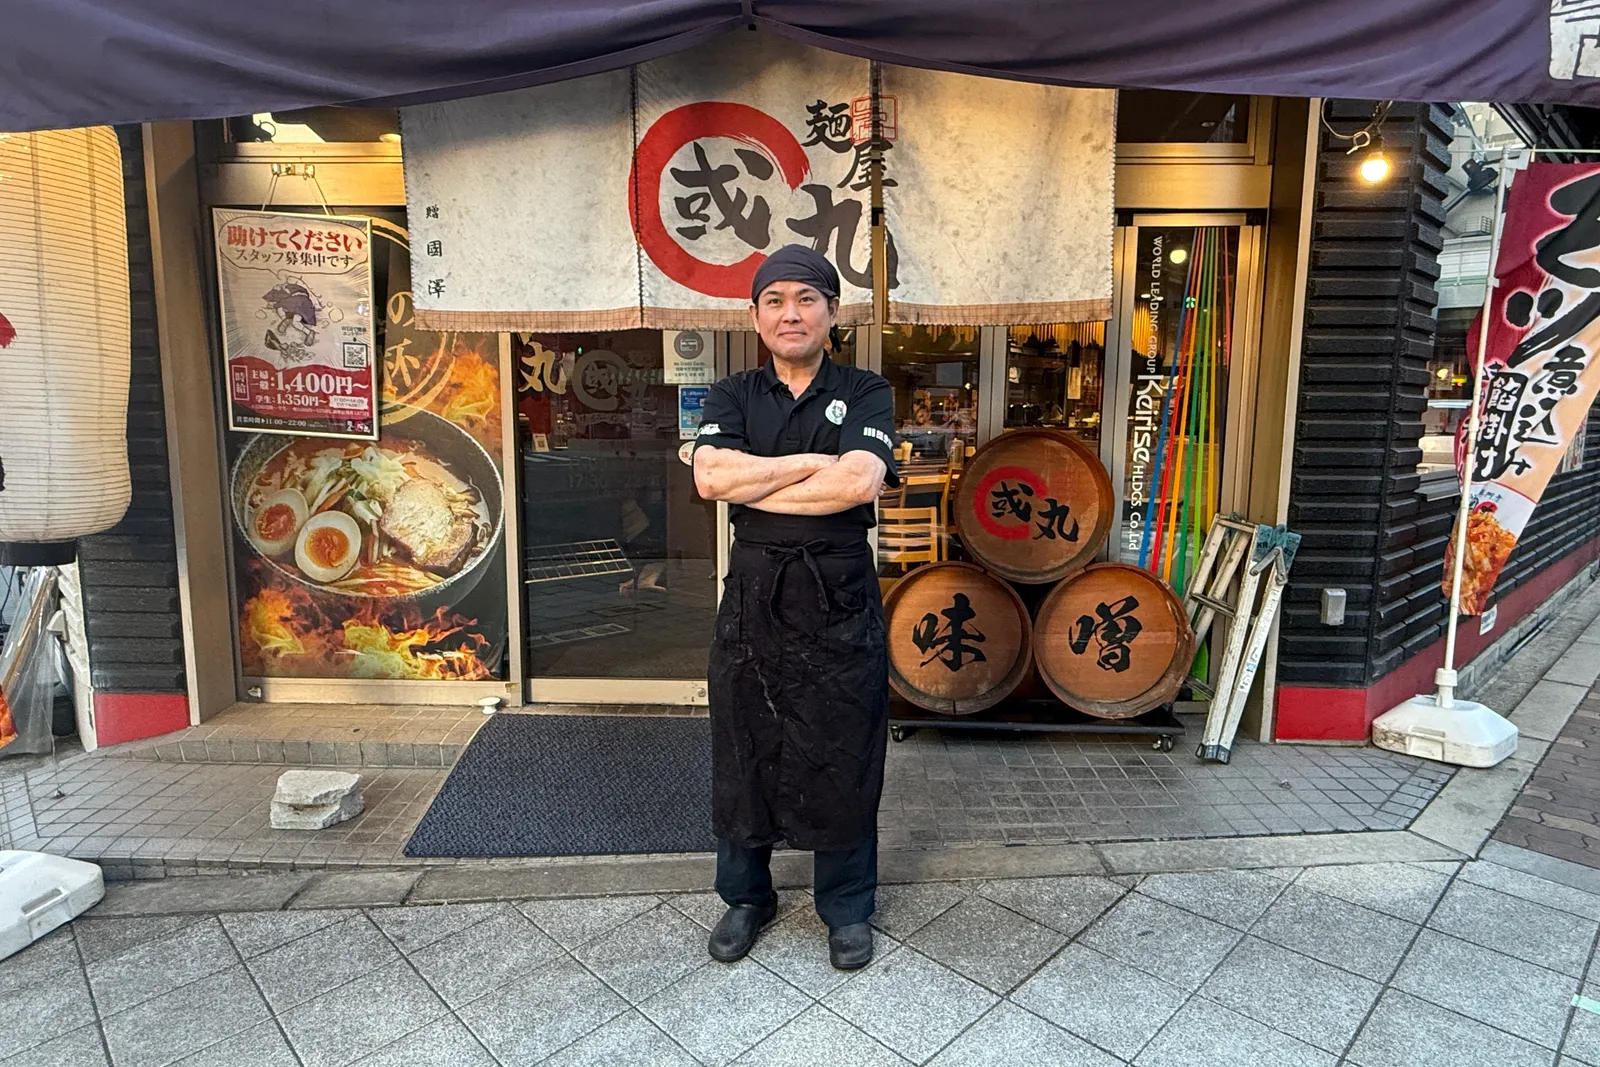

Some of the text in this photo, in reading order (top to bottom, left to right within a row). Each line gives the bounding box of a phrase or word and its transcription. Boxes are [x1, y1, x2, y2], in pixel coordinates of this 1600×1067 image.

[800, 99, 899, 192] 麺屋
[227, 224, 363, 253] 助けてください
[235, 248, 354, 269] スタッフ募集中です
[1152, 236, 1163, 279] WORLD
[1149, 282, 1161, 332] LEADING
[1146, 335, 1158, 374] GROUP
[1130, 465, 1145, 509] HLDGS.
[990, 480, 1080, 542] 或丸
[911, 592, 988, 673] 味
